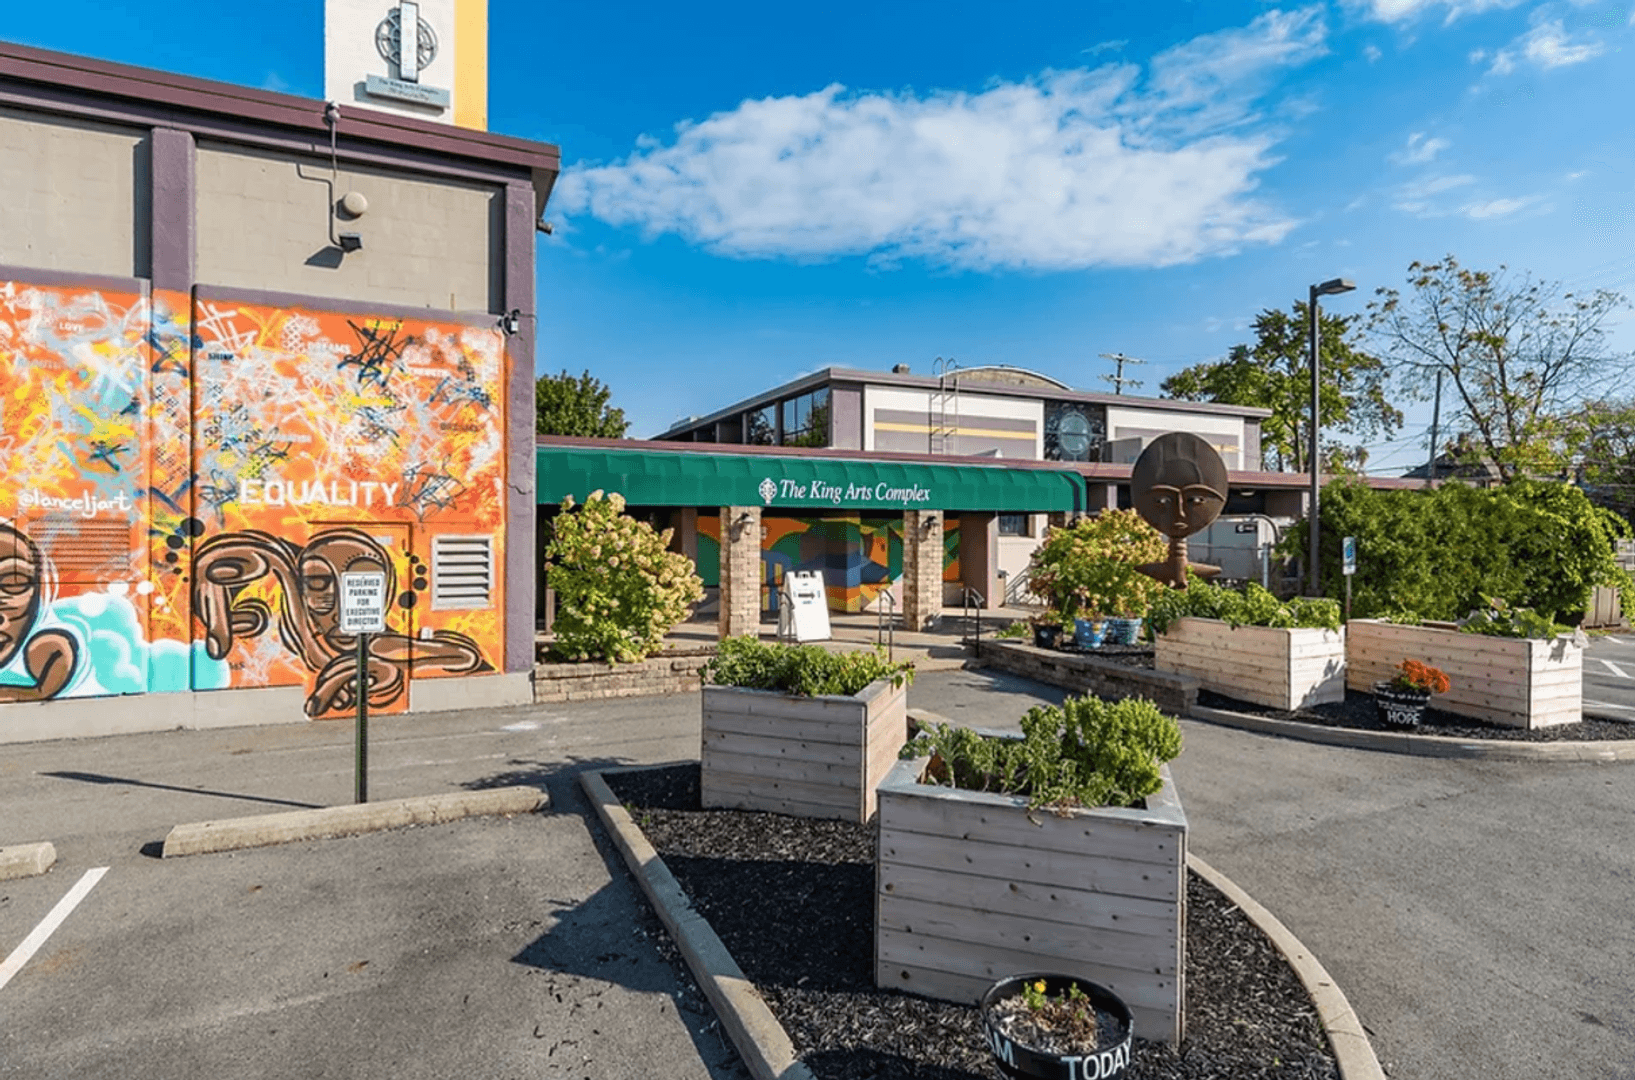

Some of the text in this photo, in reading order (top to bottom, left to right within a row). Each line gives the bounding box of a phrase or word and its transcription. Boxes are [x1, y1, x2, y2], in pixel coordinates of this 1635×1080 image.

[239, 479, 399, 507] EQUALITY
[780, 479, 931, 505] The King Arts Complex
[18, 489, 132, 517] @lanceljart
[346, 608, 380, 616] EXECUTIVE
[357, 598, 370, 606] FOR
[347, 618, 379, 626] DIRECTOR
[1386, 711, 1421, 725] HOPE
[1060, 1036, 1132, 1080] TODAY
